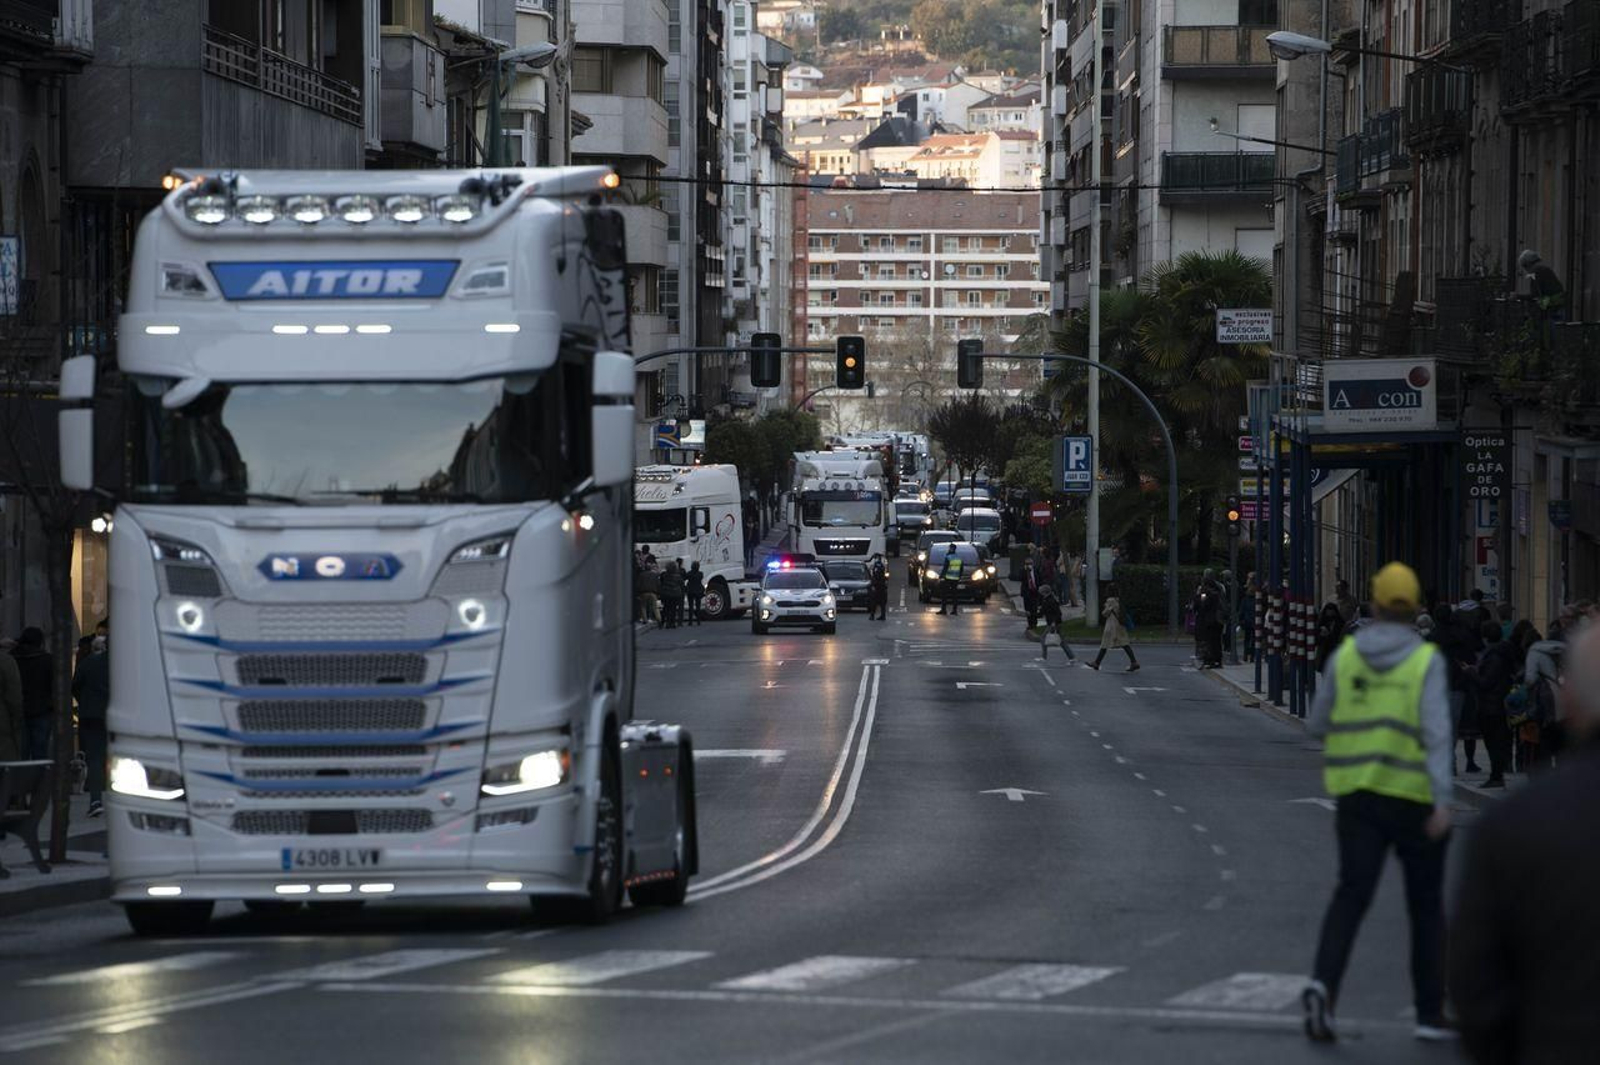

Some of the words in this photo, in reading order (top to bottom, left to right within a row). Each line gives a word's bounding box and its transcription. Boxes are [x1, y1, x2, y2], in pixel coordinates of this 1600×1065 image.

[246, 269, 423, 295] AITOR
[1477, 452, 1492, 460] LA
[1466, 463, 1505, 473] GAFA
[1478, 475, 1492, 484] DE
[1470, 486, 1501, 496] ORO
